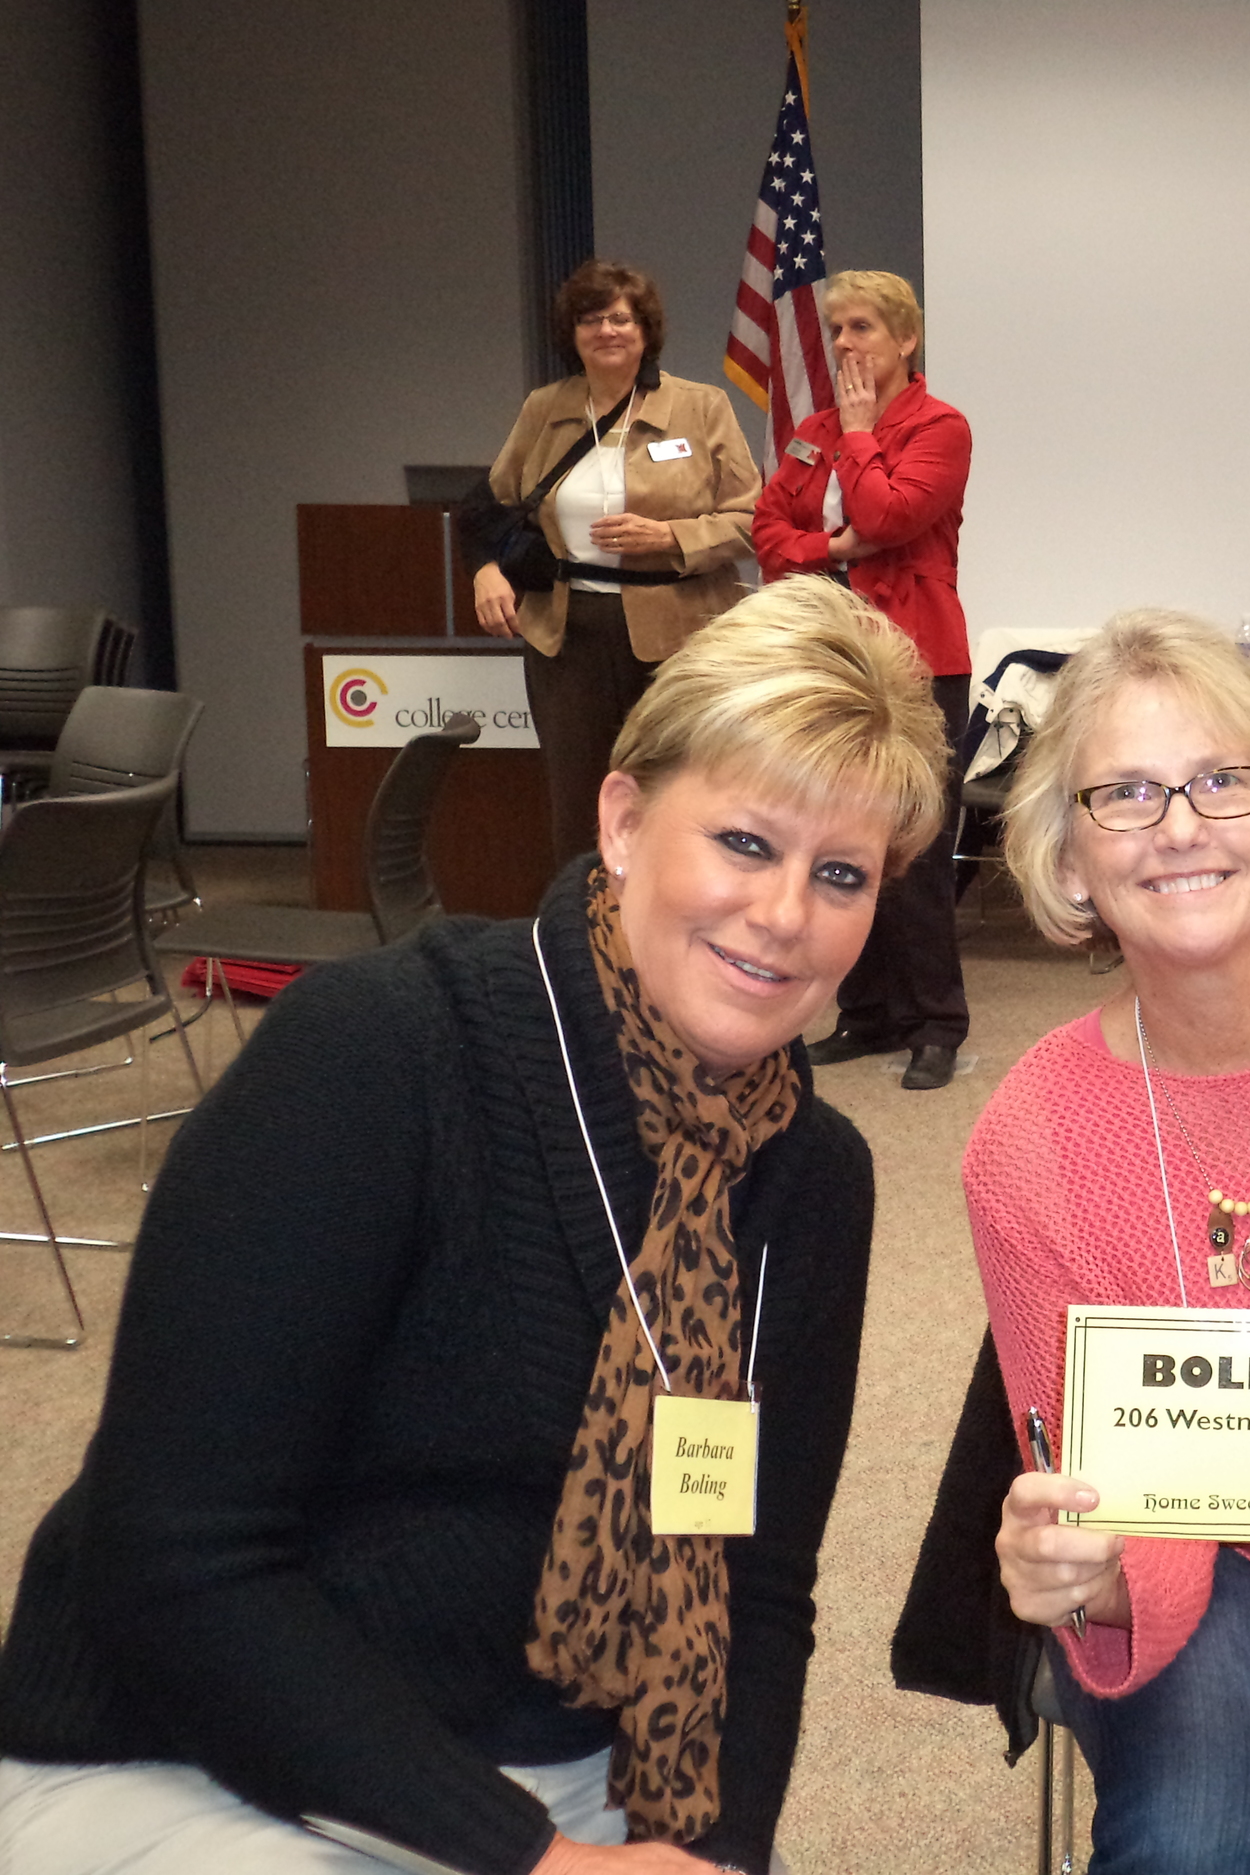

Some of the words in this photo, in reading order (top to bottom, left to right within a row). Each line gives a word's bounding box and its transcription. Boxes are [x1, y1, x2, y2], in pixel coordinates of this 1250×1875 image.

[395, 697, 486, 729] collee
[1214, 1263, 1227, 1280] K
[1113, 1407, 1159, 1429] 206
[675, 1437, 735, 1460] Barbara
[679, 1473, 727, 1501] Boling
[1143, 1493, 1201, 1514] Home
